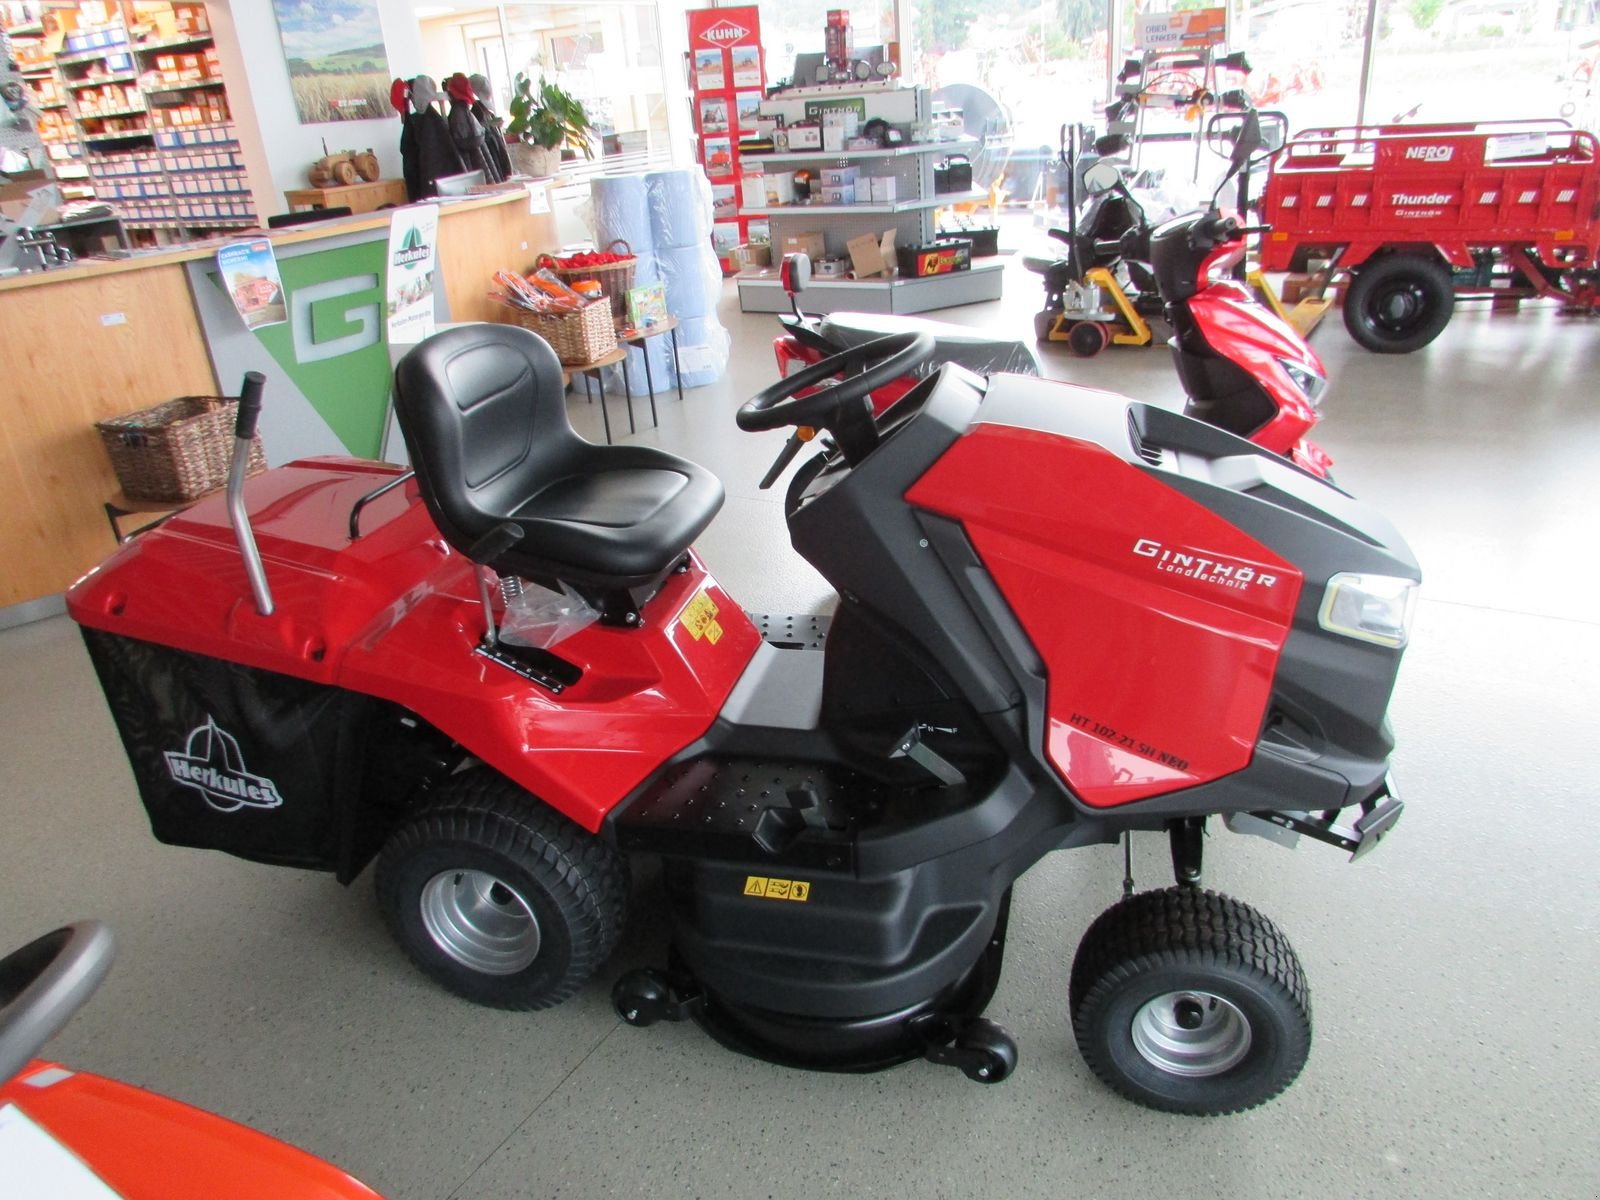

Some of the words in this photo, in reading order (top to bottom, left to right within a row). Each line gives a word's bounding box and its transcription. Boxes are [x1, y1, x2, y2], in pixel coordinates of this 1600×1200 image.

[707, 27, 743, 41] KUHN
[1146, 24, 1167, 33] OBER
[1146, 33, 1177, 43] LENKER
[1391, 192, 1453, 206] Thunder
[1071, 713, 1090, 727] HT
[1138, 743, 1156, 757] SH
[1157, 751, 1189, 771] NEO
[170, 758, 276, 802] Herkules
